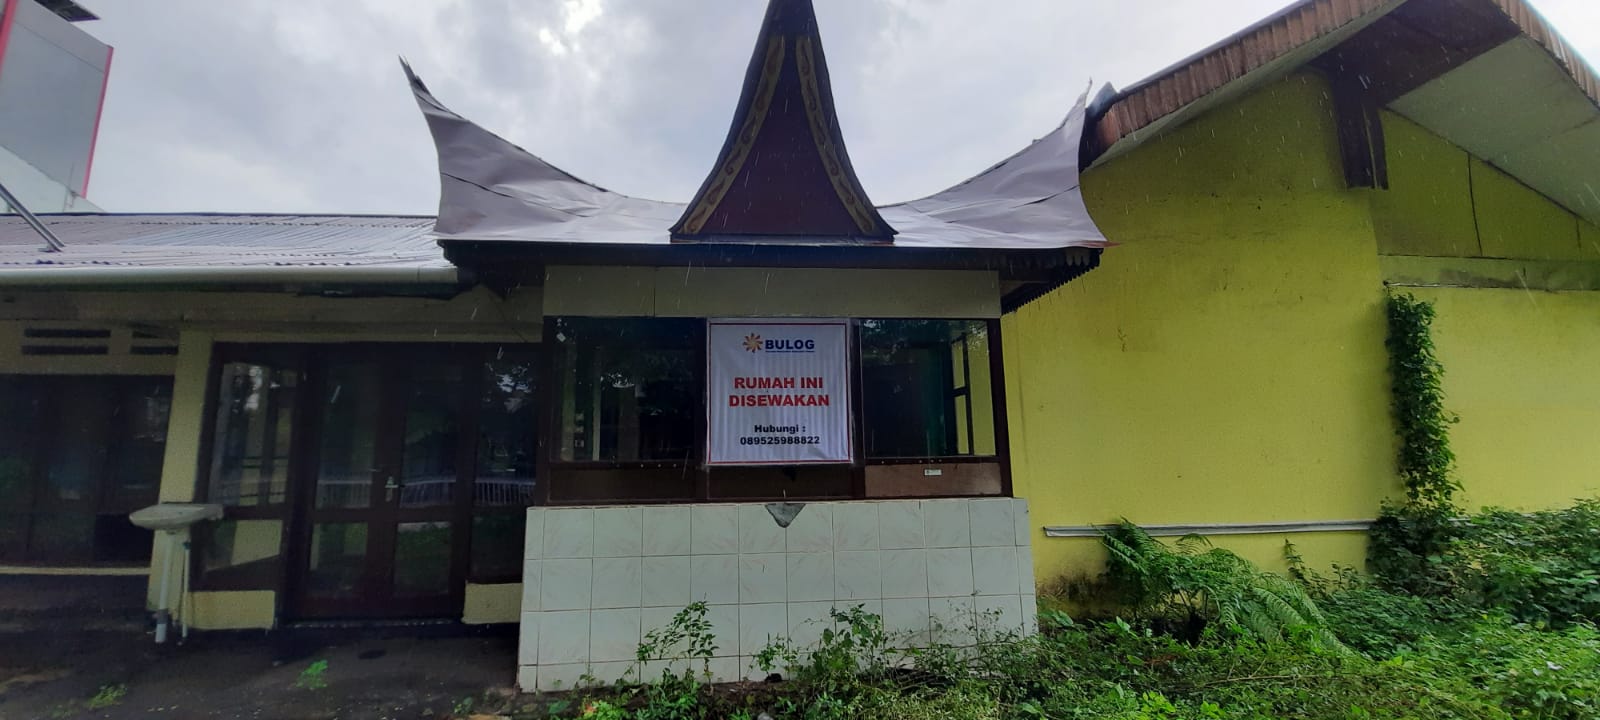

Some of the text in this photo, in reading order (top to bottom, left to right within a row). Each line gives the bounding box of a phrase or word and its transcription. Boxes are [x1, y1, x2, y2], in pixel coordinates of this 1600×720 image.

[765, 339, 815, 350] BULOG
[734, 377, 824, 389] RUMAH INI
[729, 394, 830, 407] DISEWAKAN
[754, 424, 799, 434] Hubungi
[740, 436, 820, 446] 089525988822
